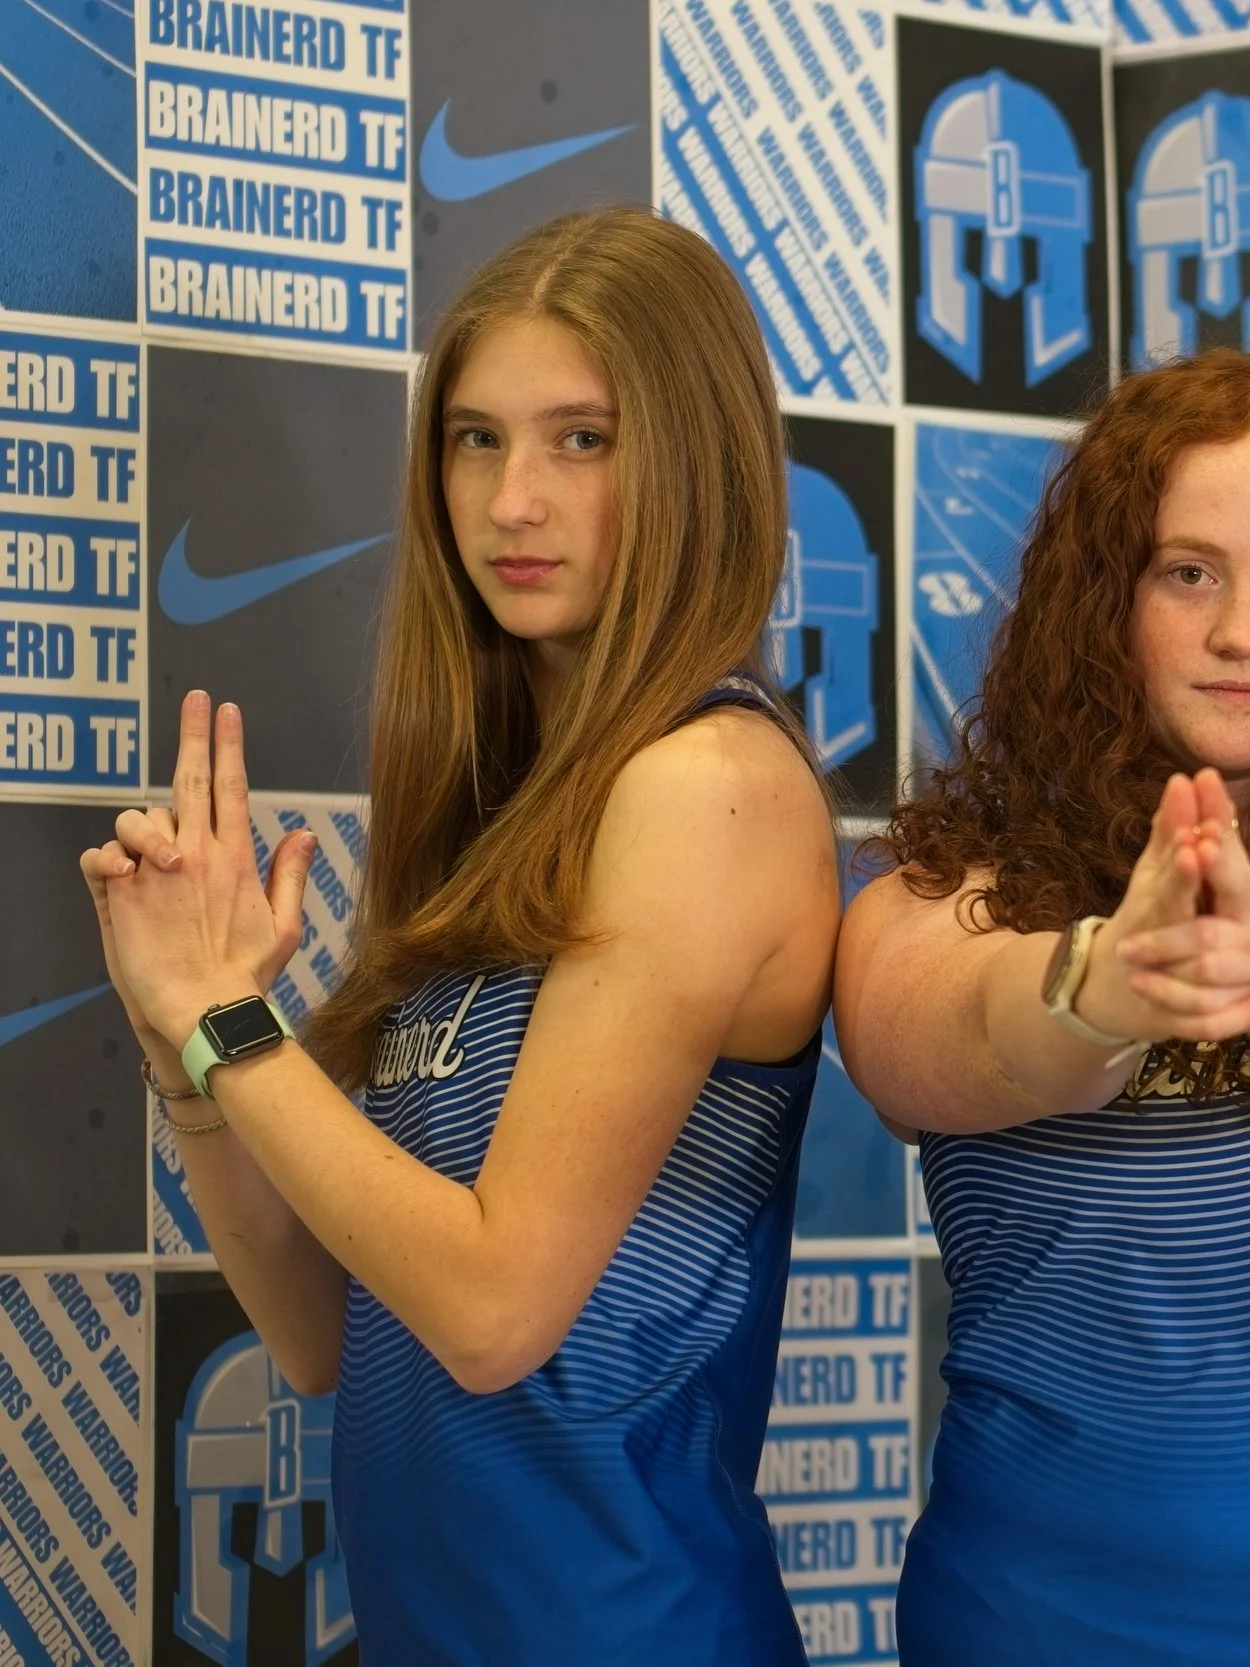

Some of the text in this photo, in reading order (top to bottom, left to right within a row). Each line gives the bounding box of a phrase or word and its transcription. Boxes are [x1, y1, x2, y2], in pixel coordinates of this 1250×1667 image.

[150, 0, 402, 81] BRAINERD TF
[149, 80, 404, 170] BRAINERD TF
[150, 168, 402, 252] BRAINERD TF
[149, 256, 404, 339] BRAINERD TF
[90, 359, 137, 420] TF
[90, 445, 136, 504] TF
[90, 537, 137, 597] TF
[90, 626, 136, 684] TF
[90, 716, 136, 775] TF
[869, 1274, 908, 1328] TF
[0, 1274, 72, 1389] ARRIORS
[869, 1353, 907, 1403] TF
[21, 1412, 112, 1550] WARRIORS
[868, 1435, 908, 1490] TF
[870, 1516, 906, 1568] TF
